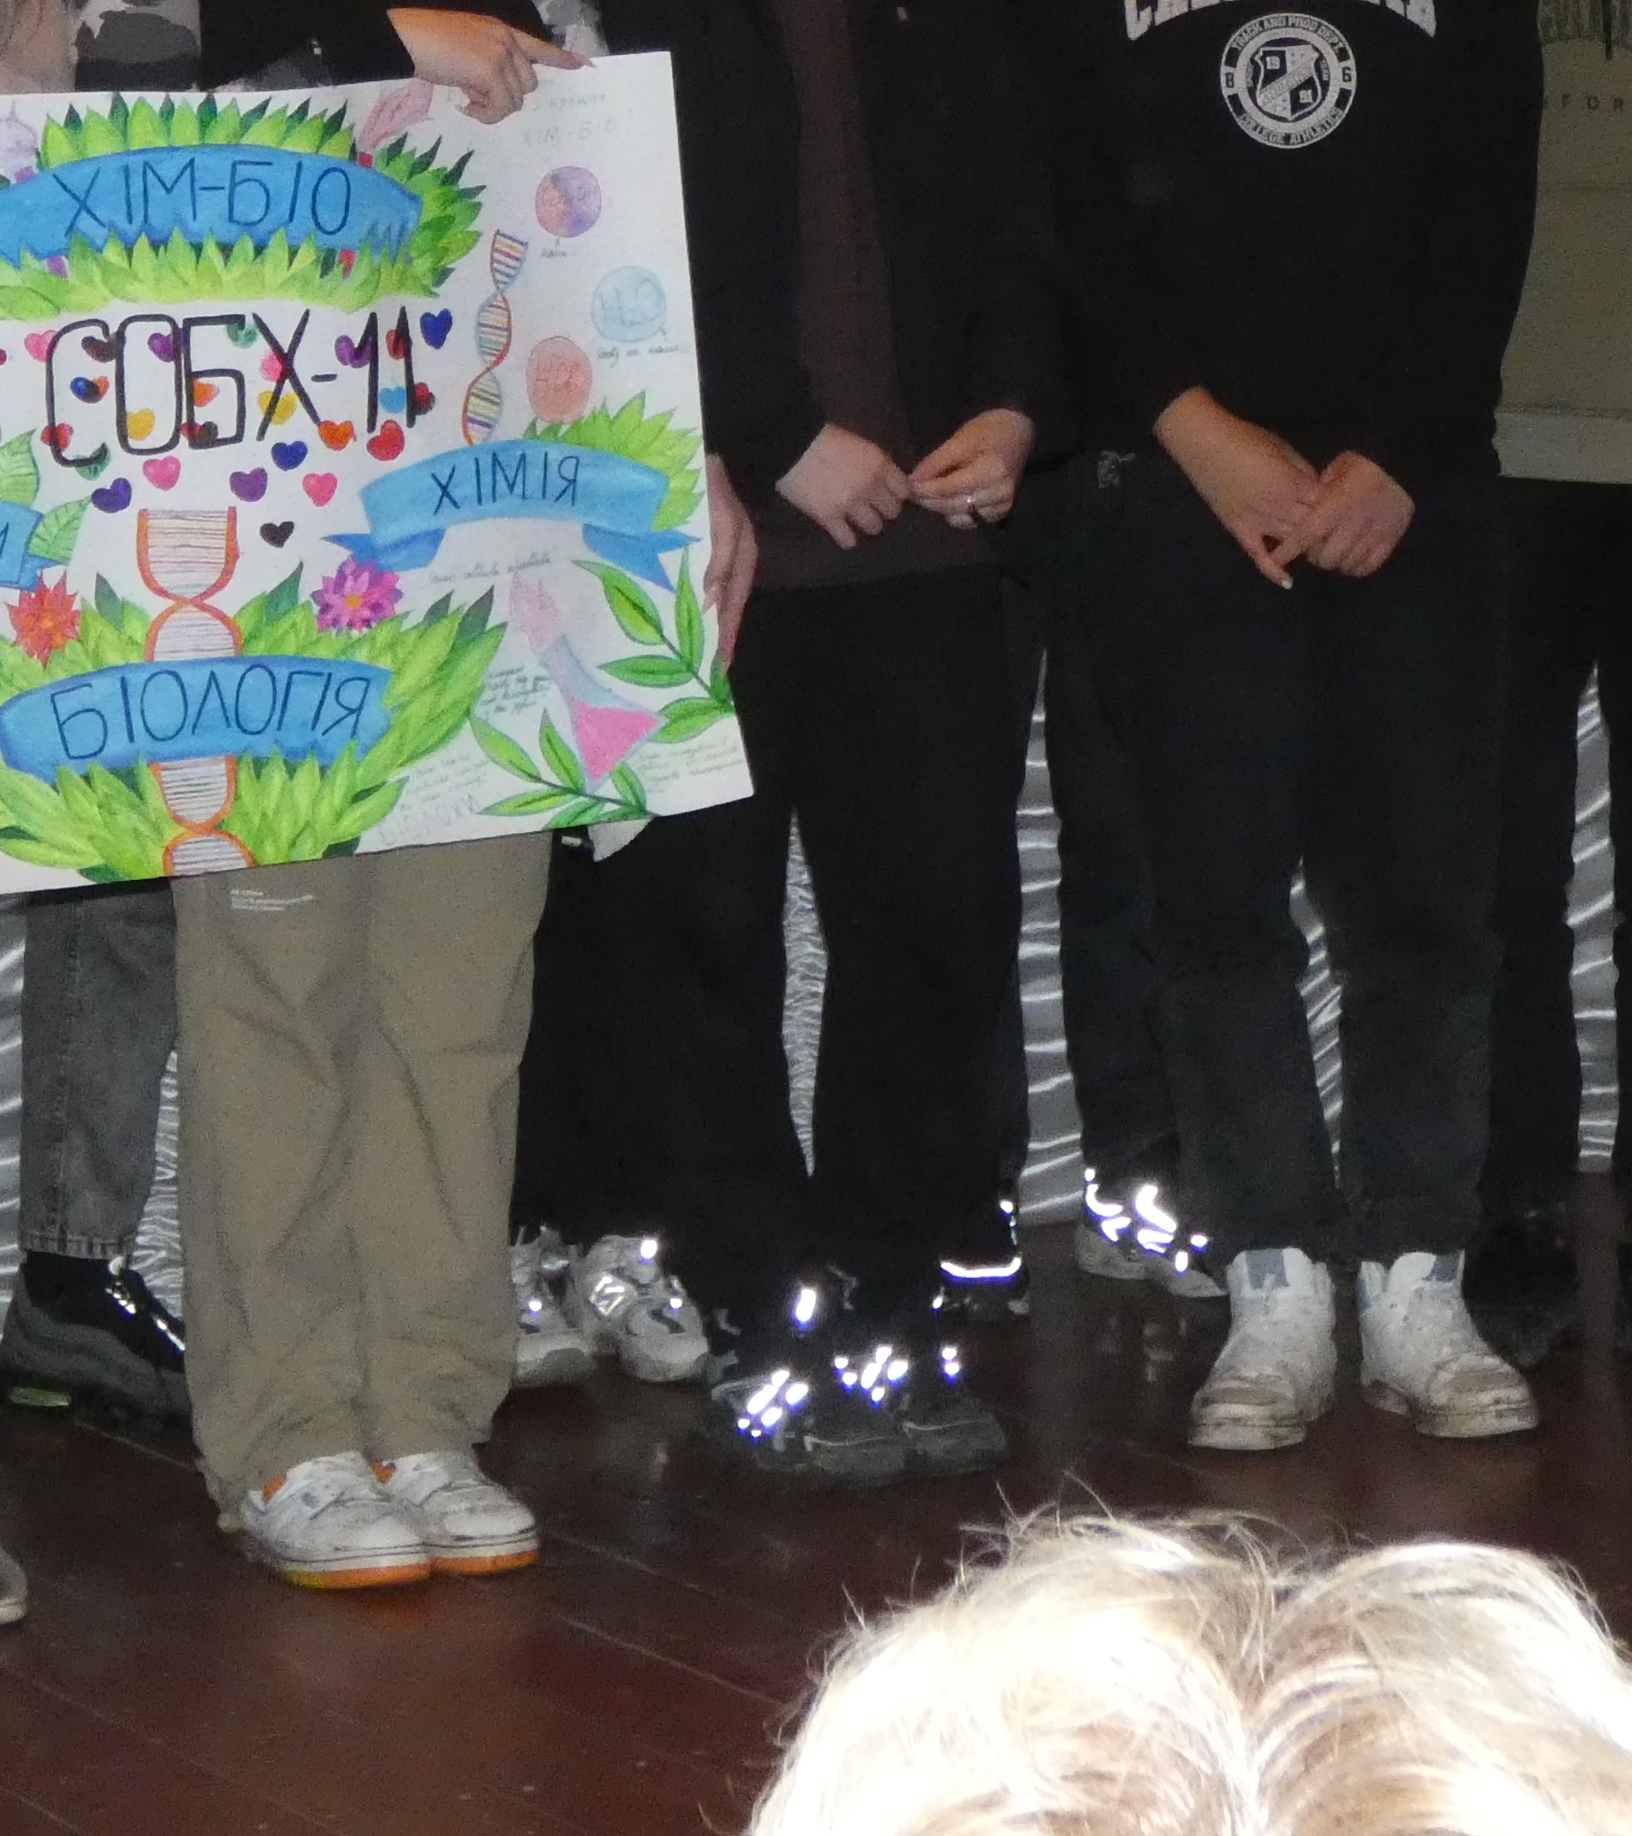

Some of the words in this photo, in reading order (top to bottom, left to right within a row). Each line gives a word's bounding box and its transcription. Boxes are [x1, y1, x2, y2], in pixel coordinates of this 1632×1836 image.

[52, 157, 352, 238] ХІМ-БІО
[431, 451, 582, 516] ХІМІЯ
[49, 669, 372, 761] БІОЛОГІЯ
